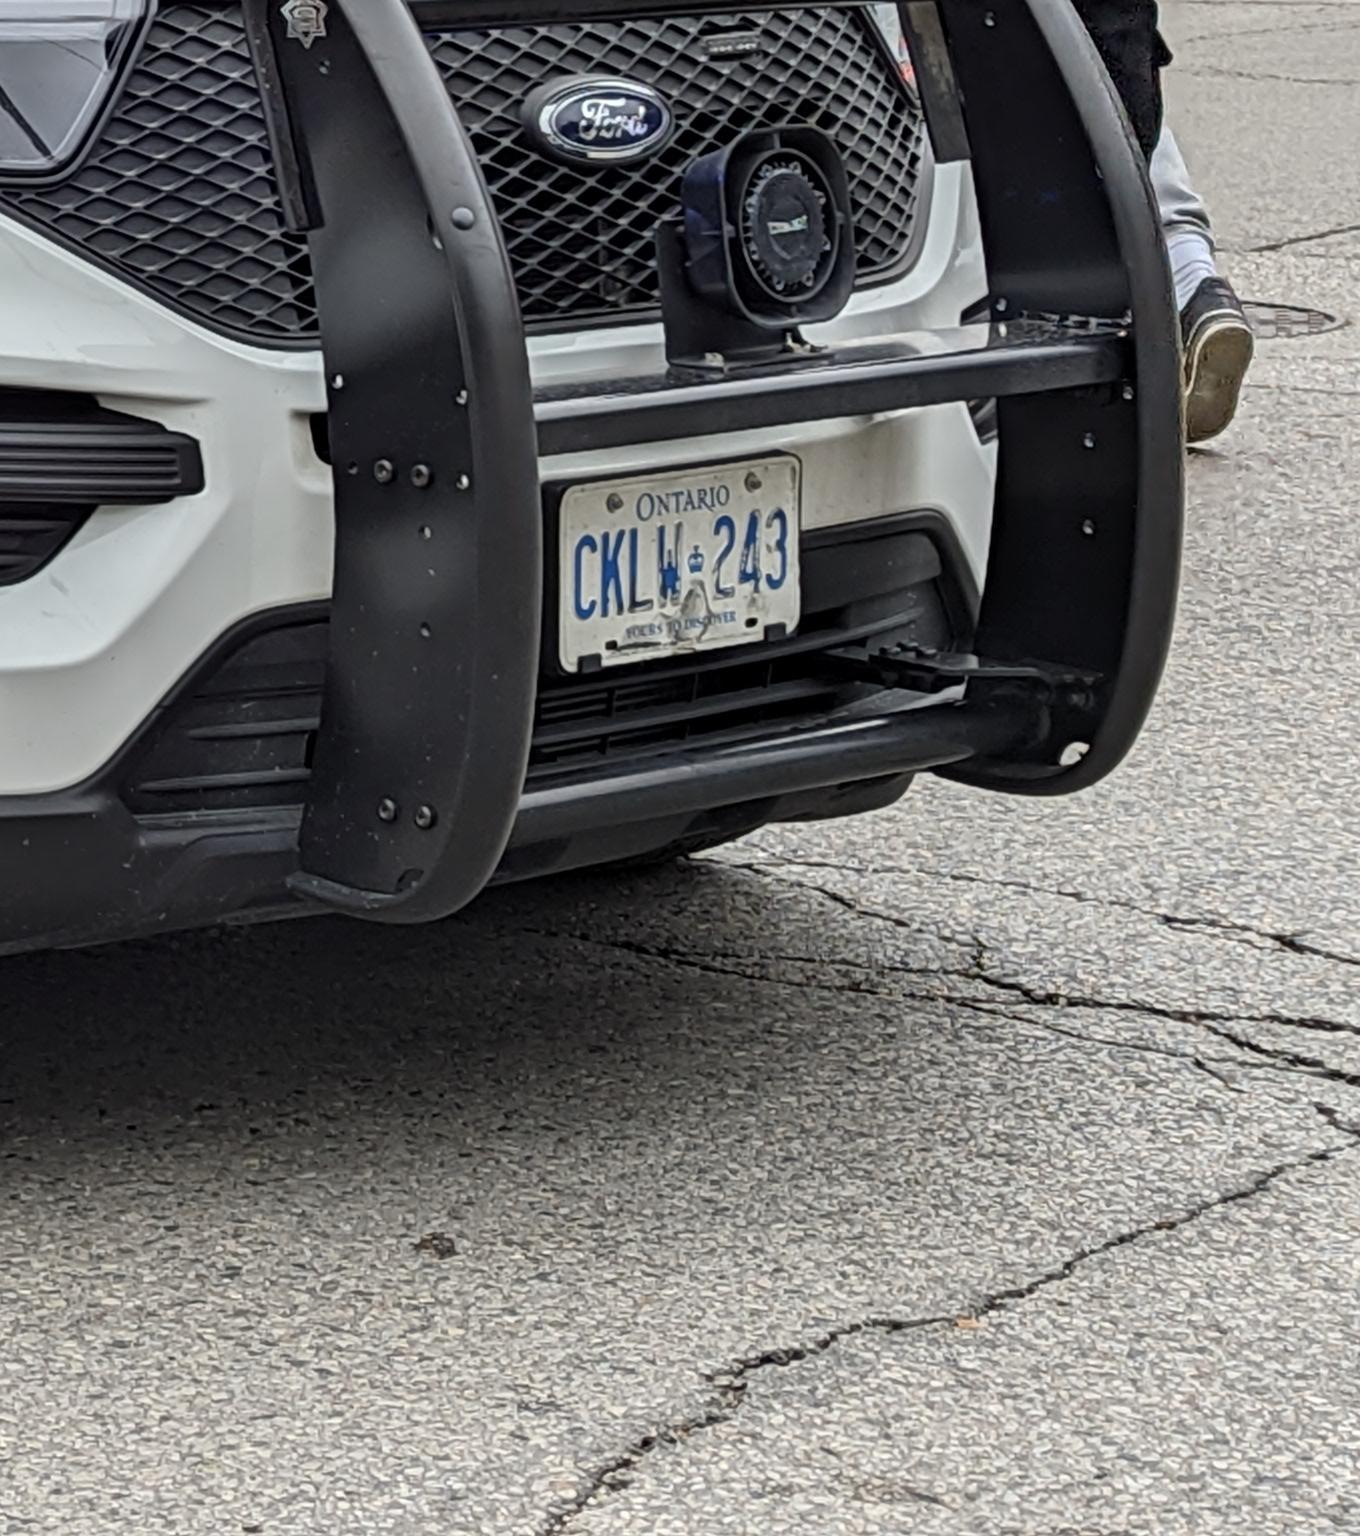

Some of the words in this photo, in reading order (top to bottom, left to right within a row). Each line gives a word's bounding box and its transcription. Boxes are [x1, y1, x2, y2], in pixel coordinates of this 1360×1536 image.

[579, 97, 649, 141] Ford
[636, 484, 730, 522] ONTARIO
[574, 520, 684, 620] CKLW
[712, 506, 789, 601] 243
